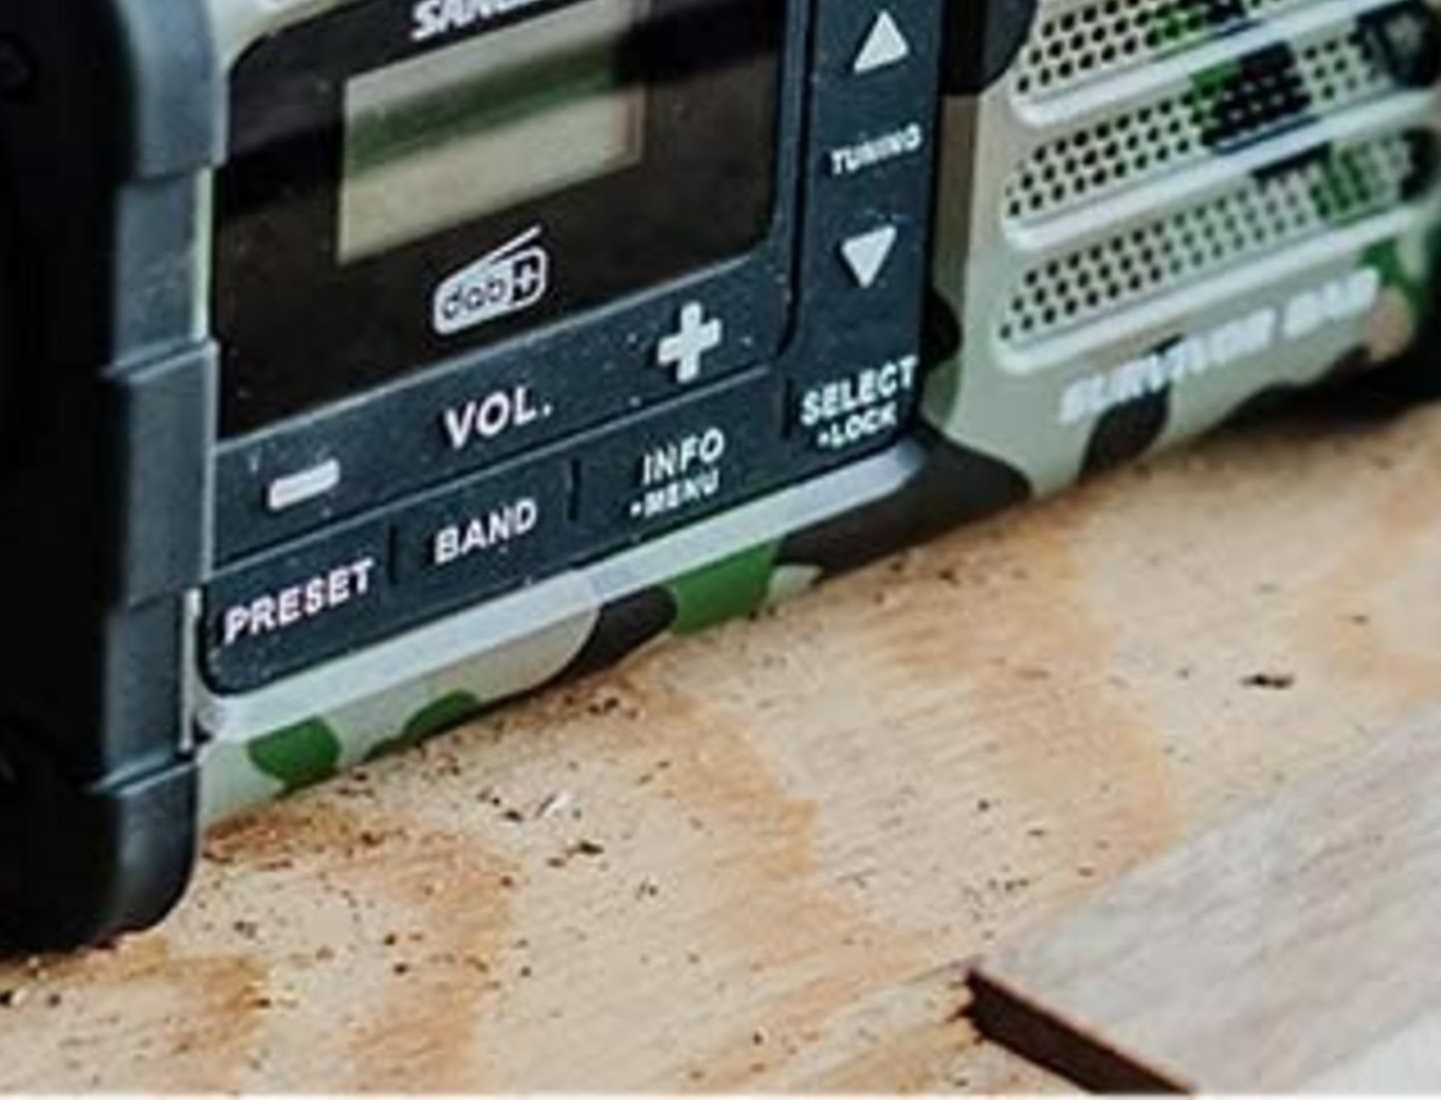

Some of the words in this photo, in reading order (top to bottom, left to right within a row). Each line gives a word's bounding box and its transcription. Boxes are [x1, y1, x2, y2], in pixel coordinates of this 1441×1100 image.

[445, 386, 552, 449] VOL.
[801, 354, 918, 427] SELECT
[642, 427, 726, 487] INFO
[433, 498, 538, 565] BAND
[221, 557, 375, 645] PRESET
